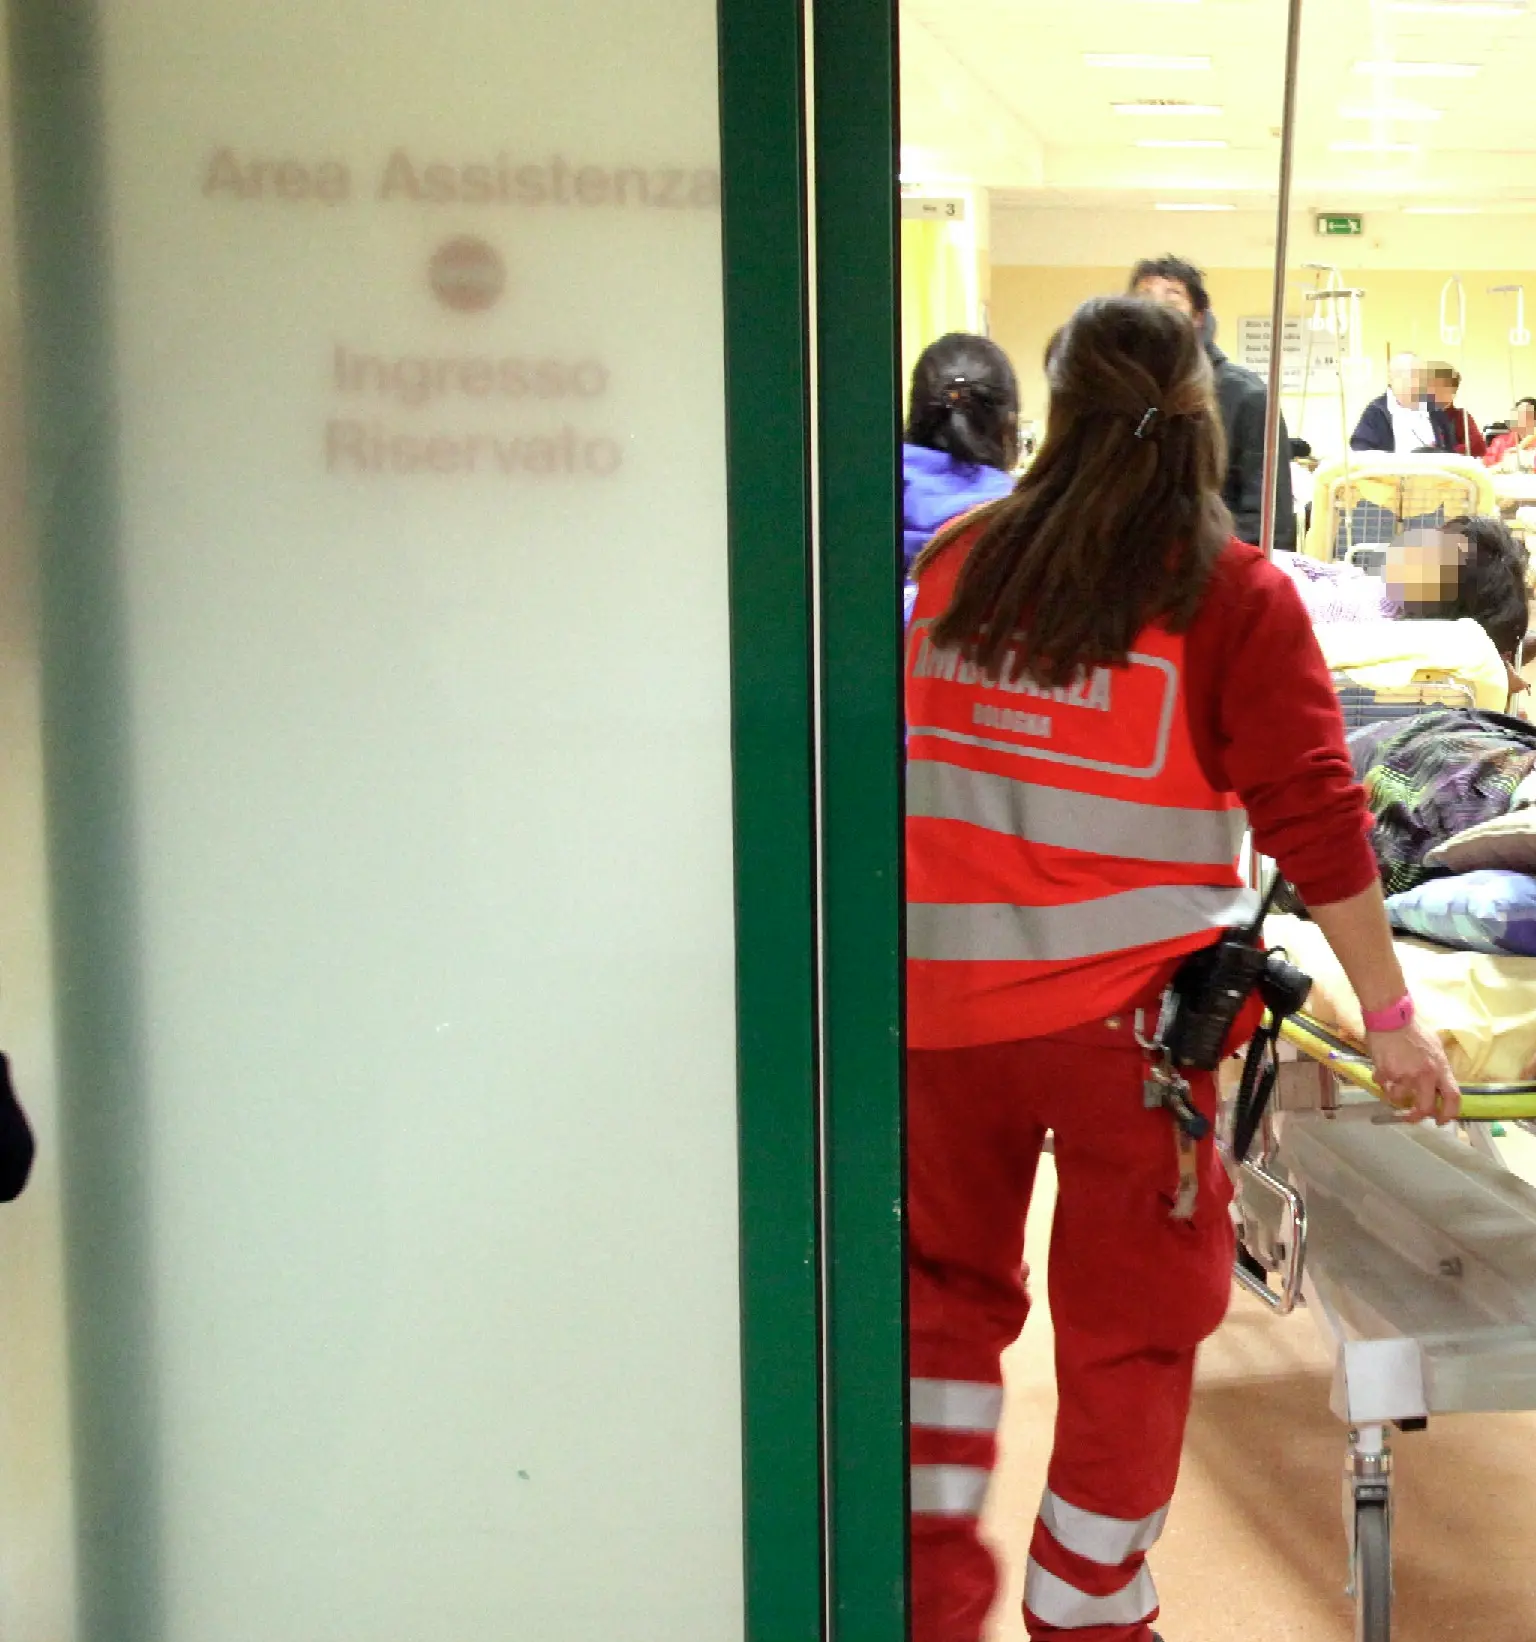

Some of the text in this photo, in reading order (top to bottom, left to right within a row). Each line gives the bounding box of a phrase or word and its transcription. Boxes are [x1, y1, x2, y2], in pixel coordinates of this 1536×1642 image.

[203, 147, 722, 206] Area Assistenza
[945, 203, 956, 217] 3
[331, 345, 610, 407] Ingresso
[324, 417, 623, 477] Riservato
[912, 636, 1112, 712] AMBLAZA
